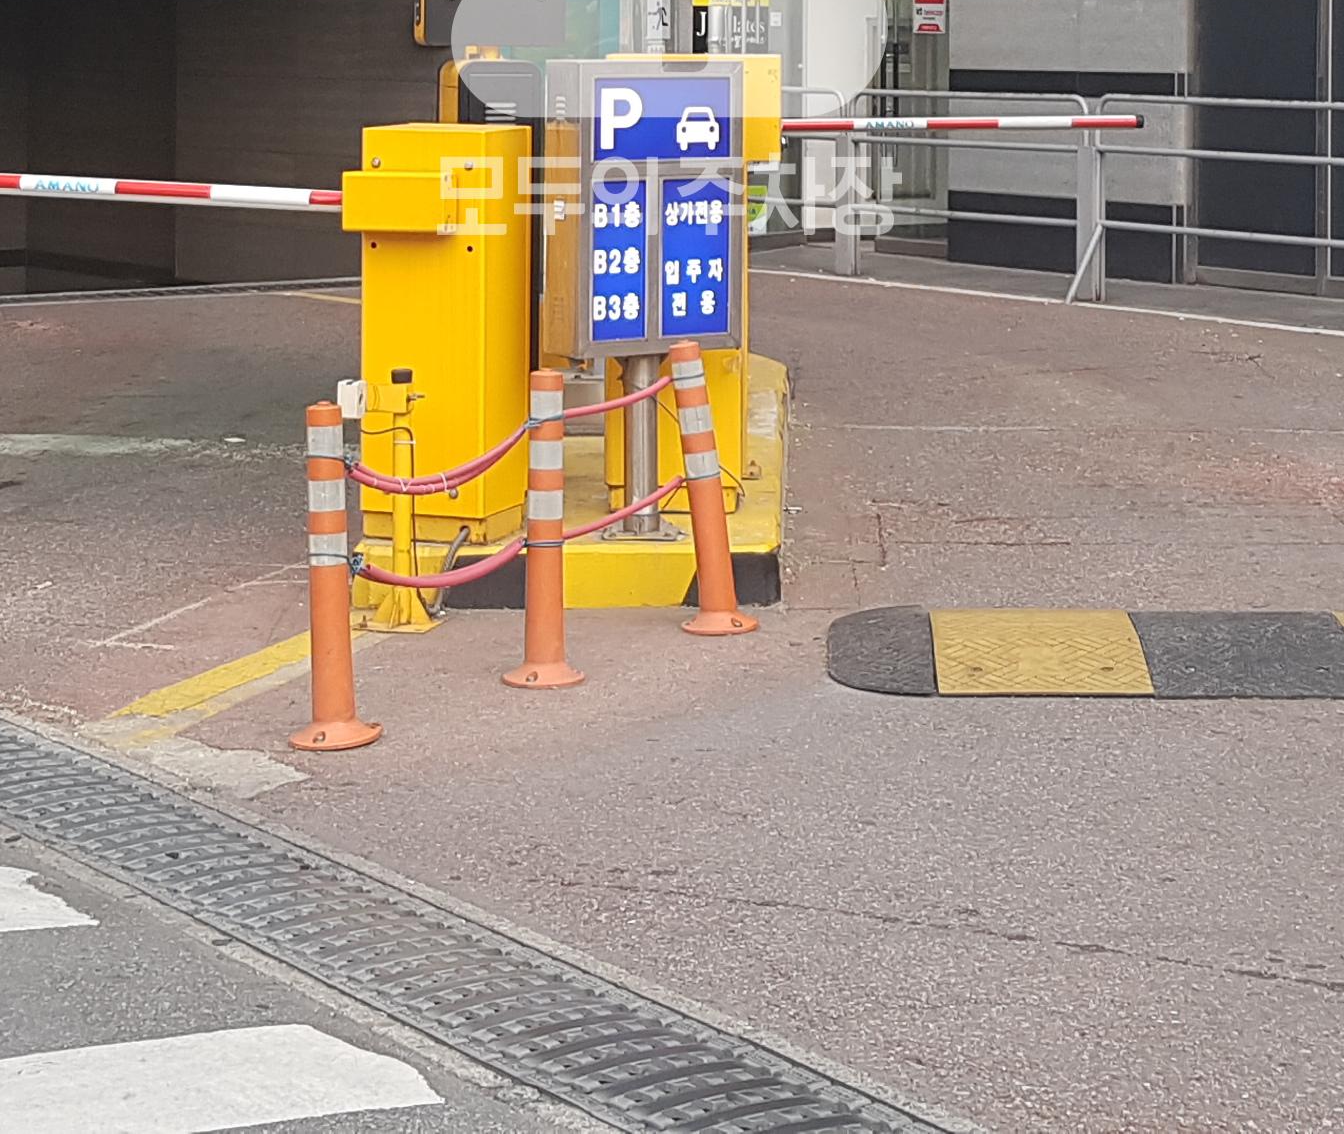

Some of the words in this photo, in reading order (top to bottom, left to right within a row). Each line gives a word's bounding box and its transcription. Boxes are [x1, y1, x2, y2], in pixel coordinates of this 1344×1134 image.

[600, 87, 643, 150] P
[594, 201, 641, 228] B1층
[665, 200, 723, 226] 상가전용
[593, 247, 640, 274] B2층
[593, 292, 640, 320] B3층
